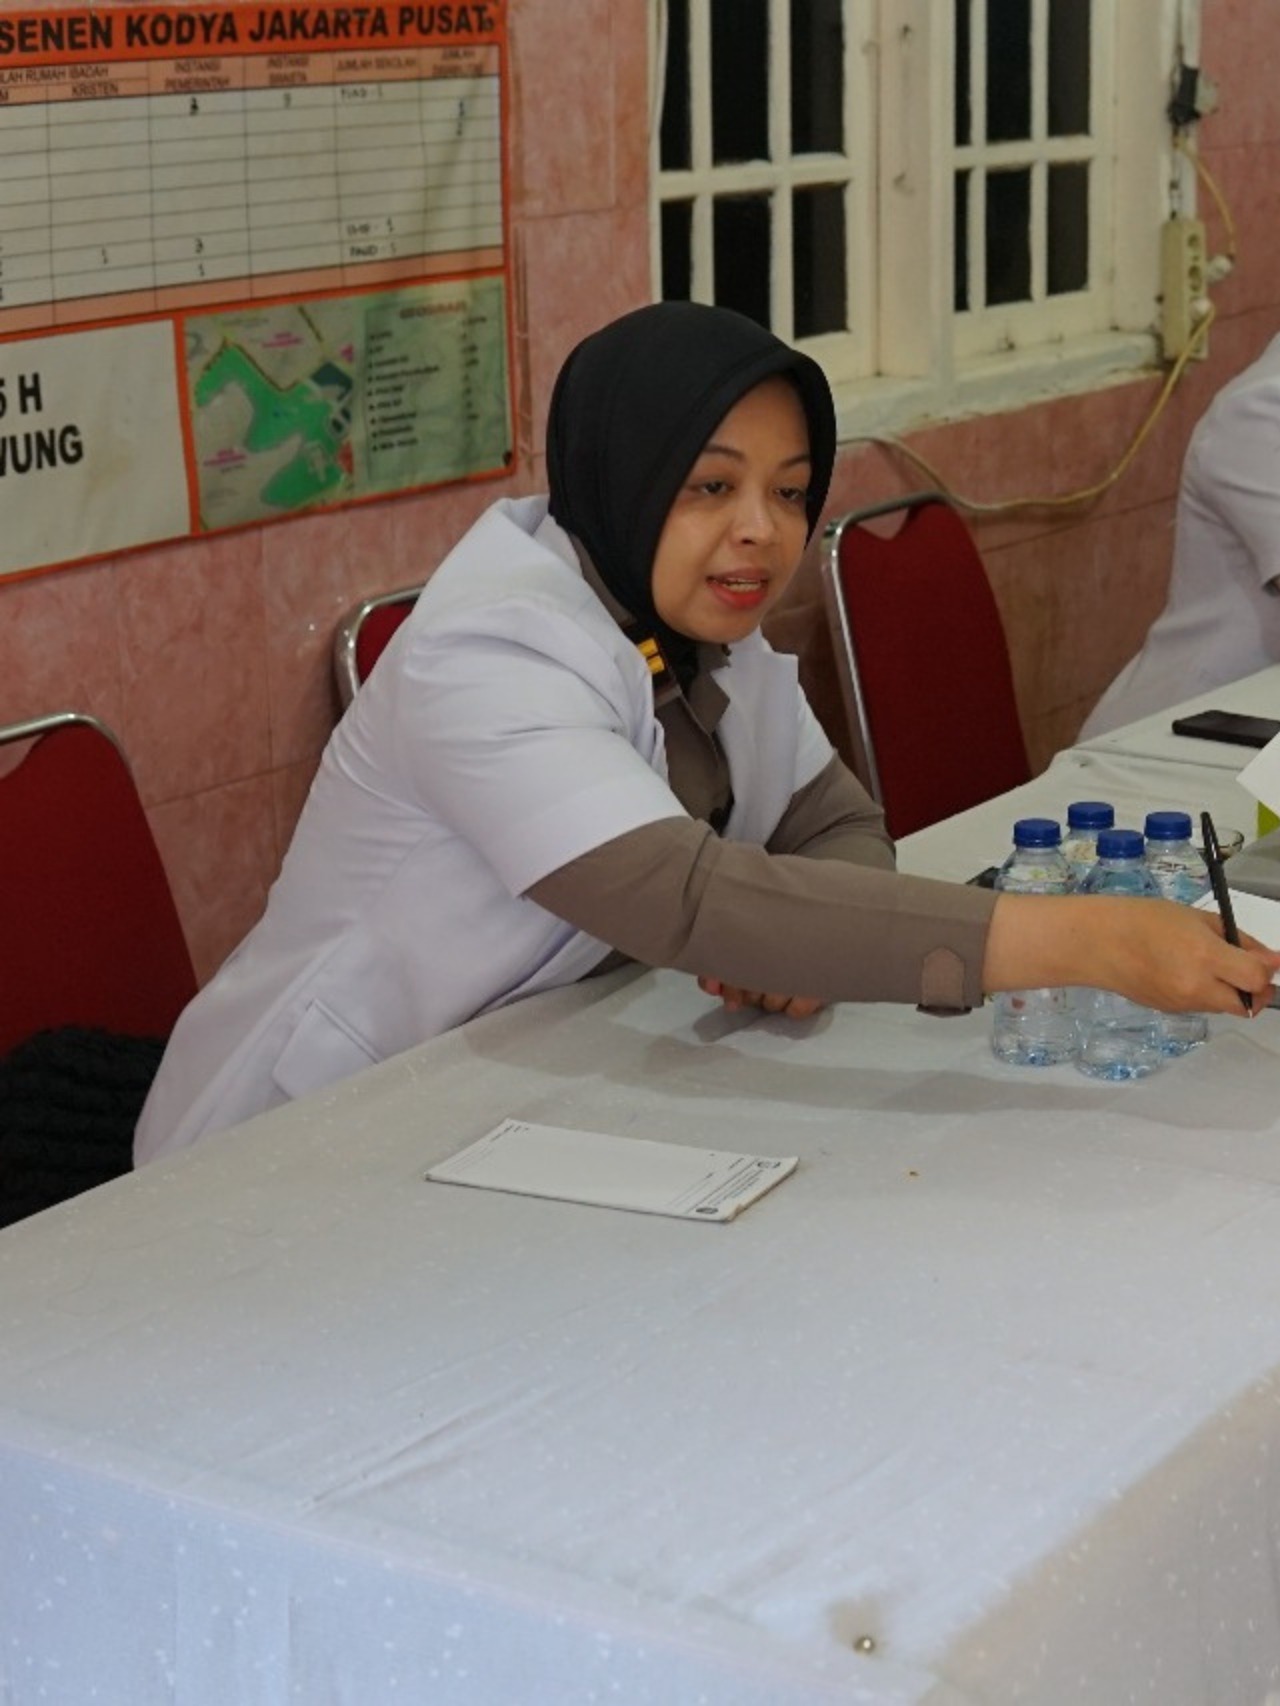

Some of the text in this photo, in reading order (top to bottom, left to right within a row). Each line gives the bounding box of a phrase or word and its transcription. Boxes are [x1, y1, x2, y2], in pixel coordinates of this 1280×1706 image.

[0, 5, 487, 53] SENEN KODYA JAKARTA PUSAT
[71, 82, 119, 97] KRISTEN
[18, 372, 42, 414] H
